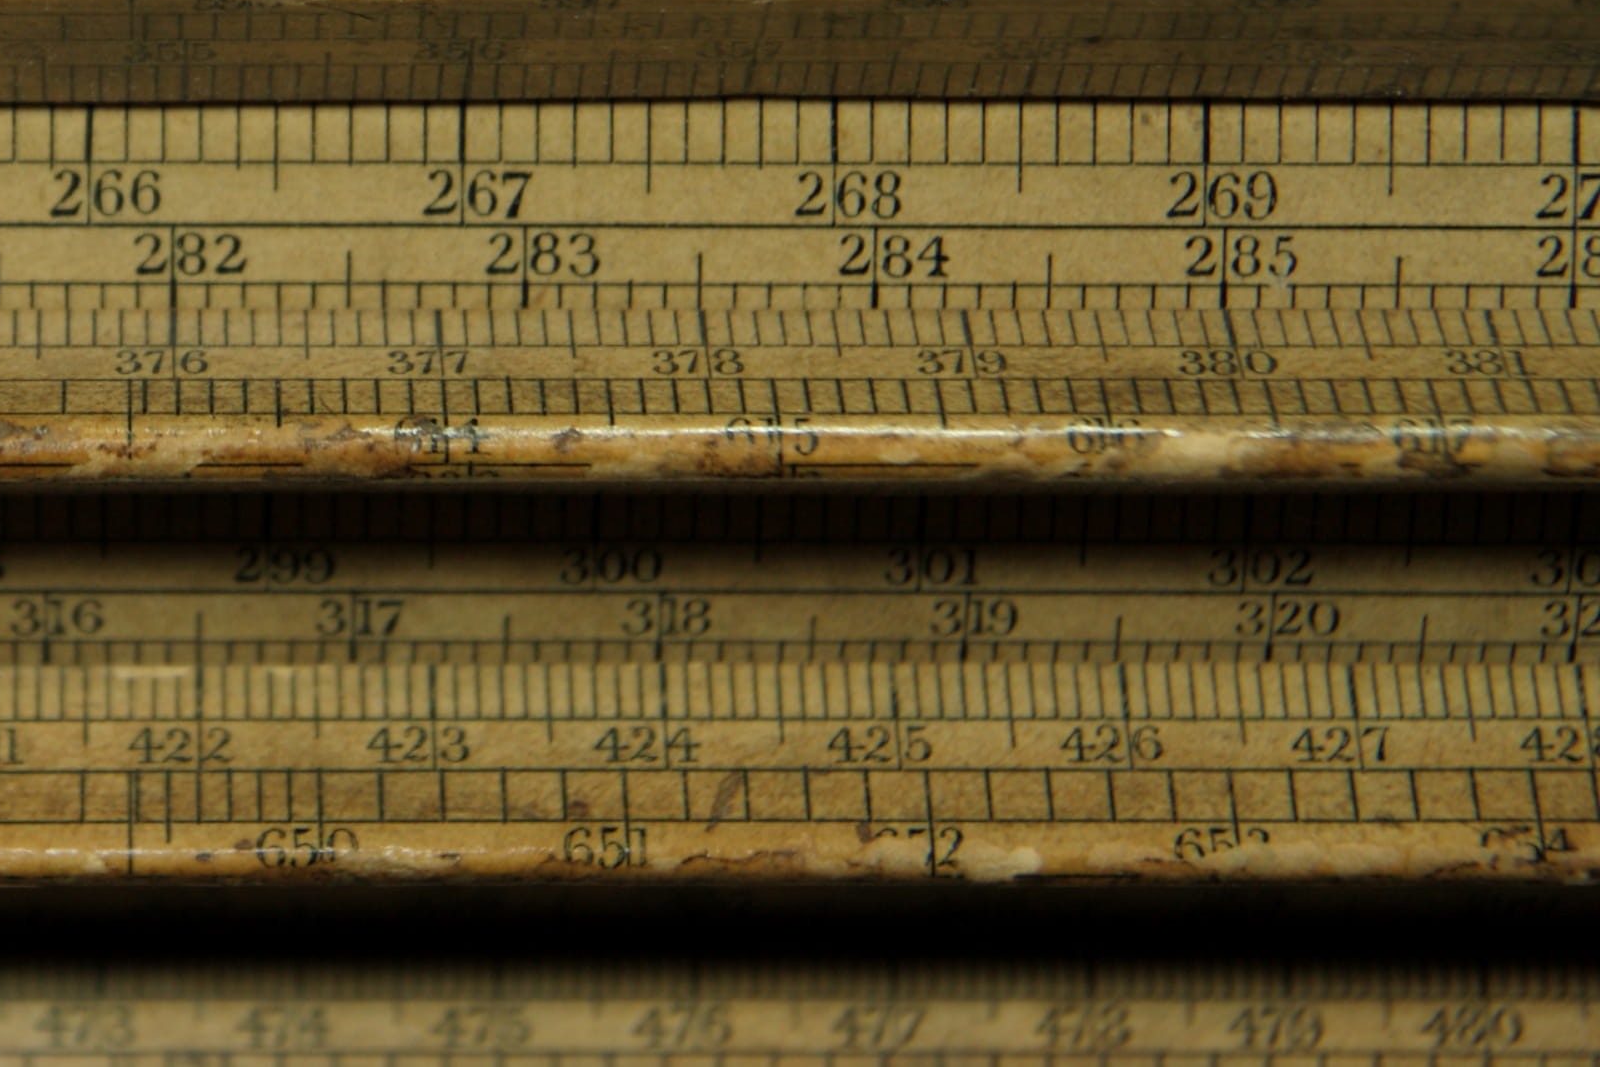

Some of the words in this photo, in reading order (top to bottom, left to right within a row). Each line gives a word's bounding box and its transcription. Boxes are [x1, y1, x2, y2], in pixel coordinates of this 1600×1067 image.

[50, 171, 162, 218] 266
[423, 172, 533, 219] 267
[798, 173, 902, 219] 268
[1169, 173, 1278, 220] 269
[134, 234, 248, 276] 282
[486, 234, 601, 278] 283
[839, 235, 949, 279] 284
[1186, 235, 1298, 279] 285
[116, 349, 208, 375] 376
[387, 349, 470, 375] 377
[653, 349, 745, 375] 378
[917, 350, 1008, 376] 379
[1179, 350, 1279, 377] 380
[1446, 350, 1538, 377] 381
[233, 547, 336, 584] 299
[561, 548, 662, 584] 300
[884, 548, 981, 584] 301
[1208, 549, 1314, 586] 302
[12, 599, 104, 635] 316
[317, 599, 403, 636] 317
[621, 599, 712, 636] 318
[931, 600, 1017, 636] 319
[1236, 601, 1339, 637] 320
[129, 728, 234, 764] 422
[367, 727, 469, 764] 423
[592, 727, 700, 764] 424
[828, 727, 933, 763] 425
[1061, 727, 1164, 763] 426
[1292, 727, 1390, 763] 427
